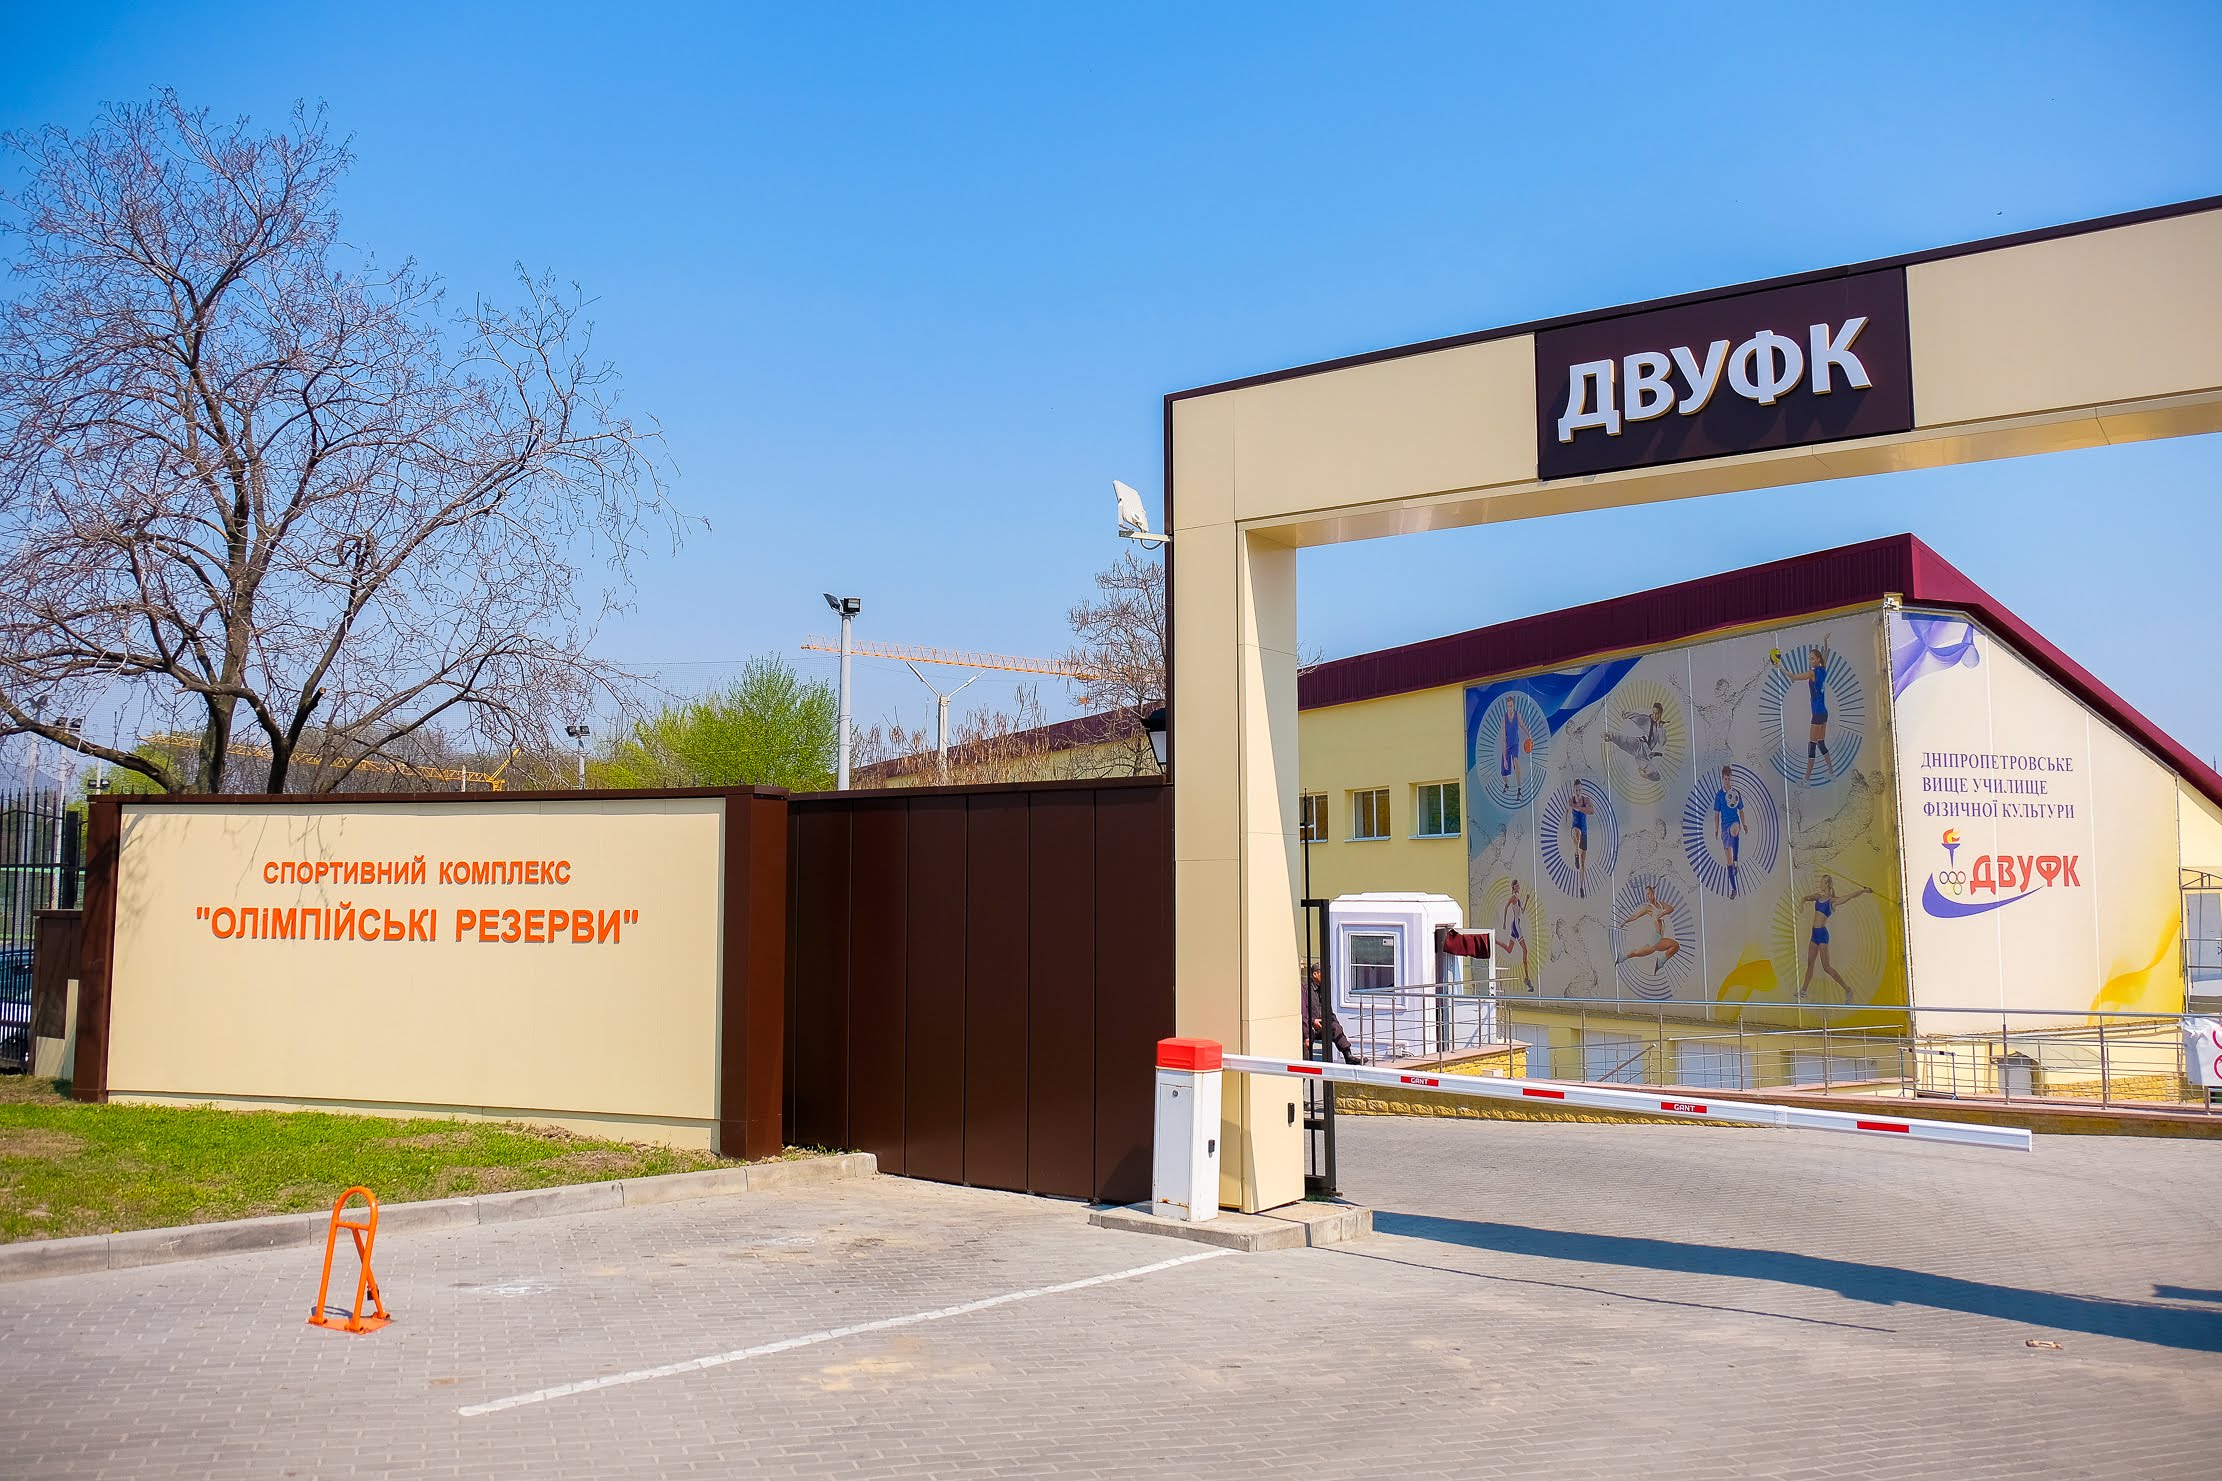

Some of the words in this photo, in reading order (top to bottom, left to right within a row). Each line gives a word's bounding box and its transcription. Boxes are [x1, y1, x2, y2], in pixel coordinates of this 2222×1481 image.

[1557, 316, 1873, 443] ДВУФК
[1921, 752, 2074, 772] ДНІПРОПЕТРОВСЬКЕ
[1922, 777, 1968, 795] ВИЩЕ
[1973, 778, 2048, 796] УЧИЛИЩЕ
[1923, 800, 1998, 818] ФІЗИЧНОЇ
[2002, 803, 2075, 819] КУЛЬТУРИ
[263, 855, 426, 884] СПОРТИВНИЙ
[439, 860, 571, 885] КОМПЛЕКС
[1969, 855, 2081, 895] ДВУФК
[455, 908, 639, 944] РЕЗЕРВИ"
[1673, 1103, 1696, 1112] GANT
